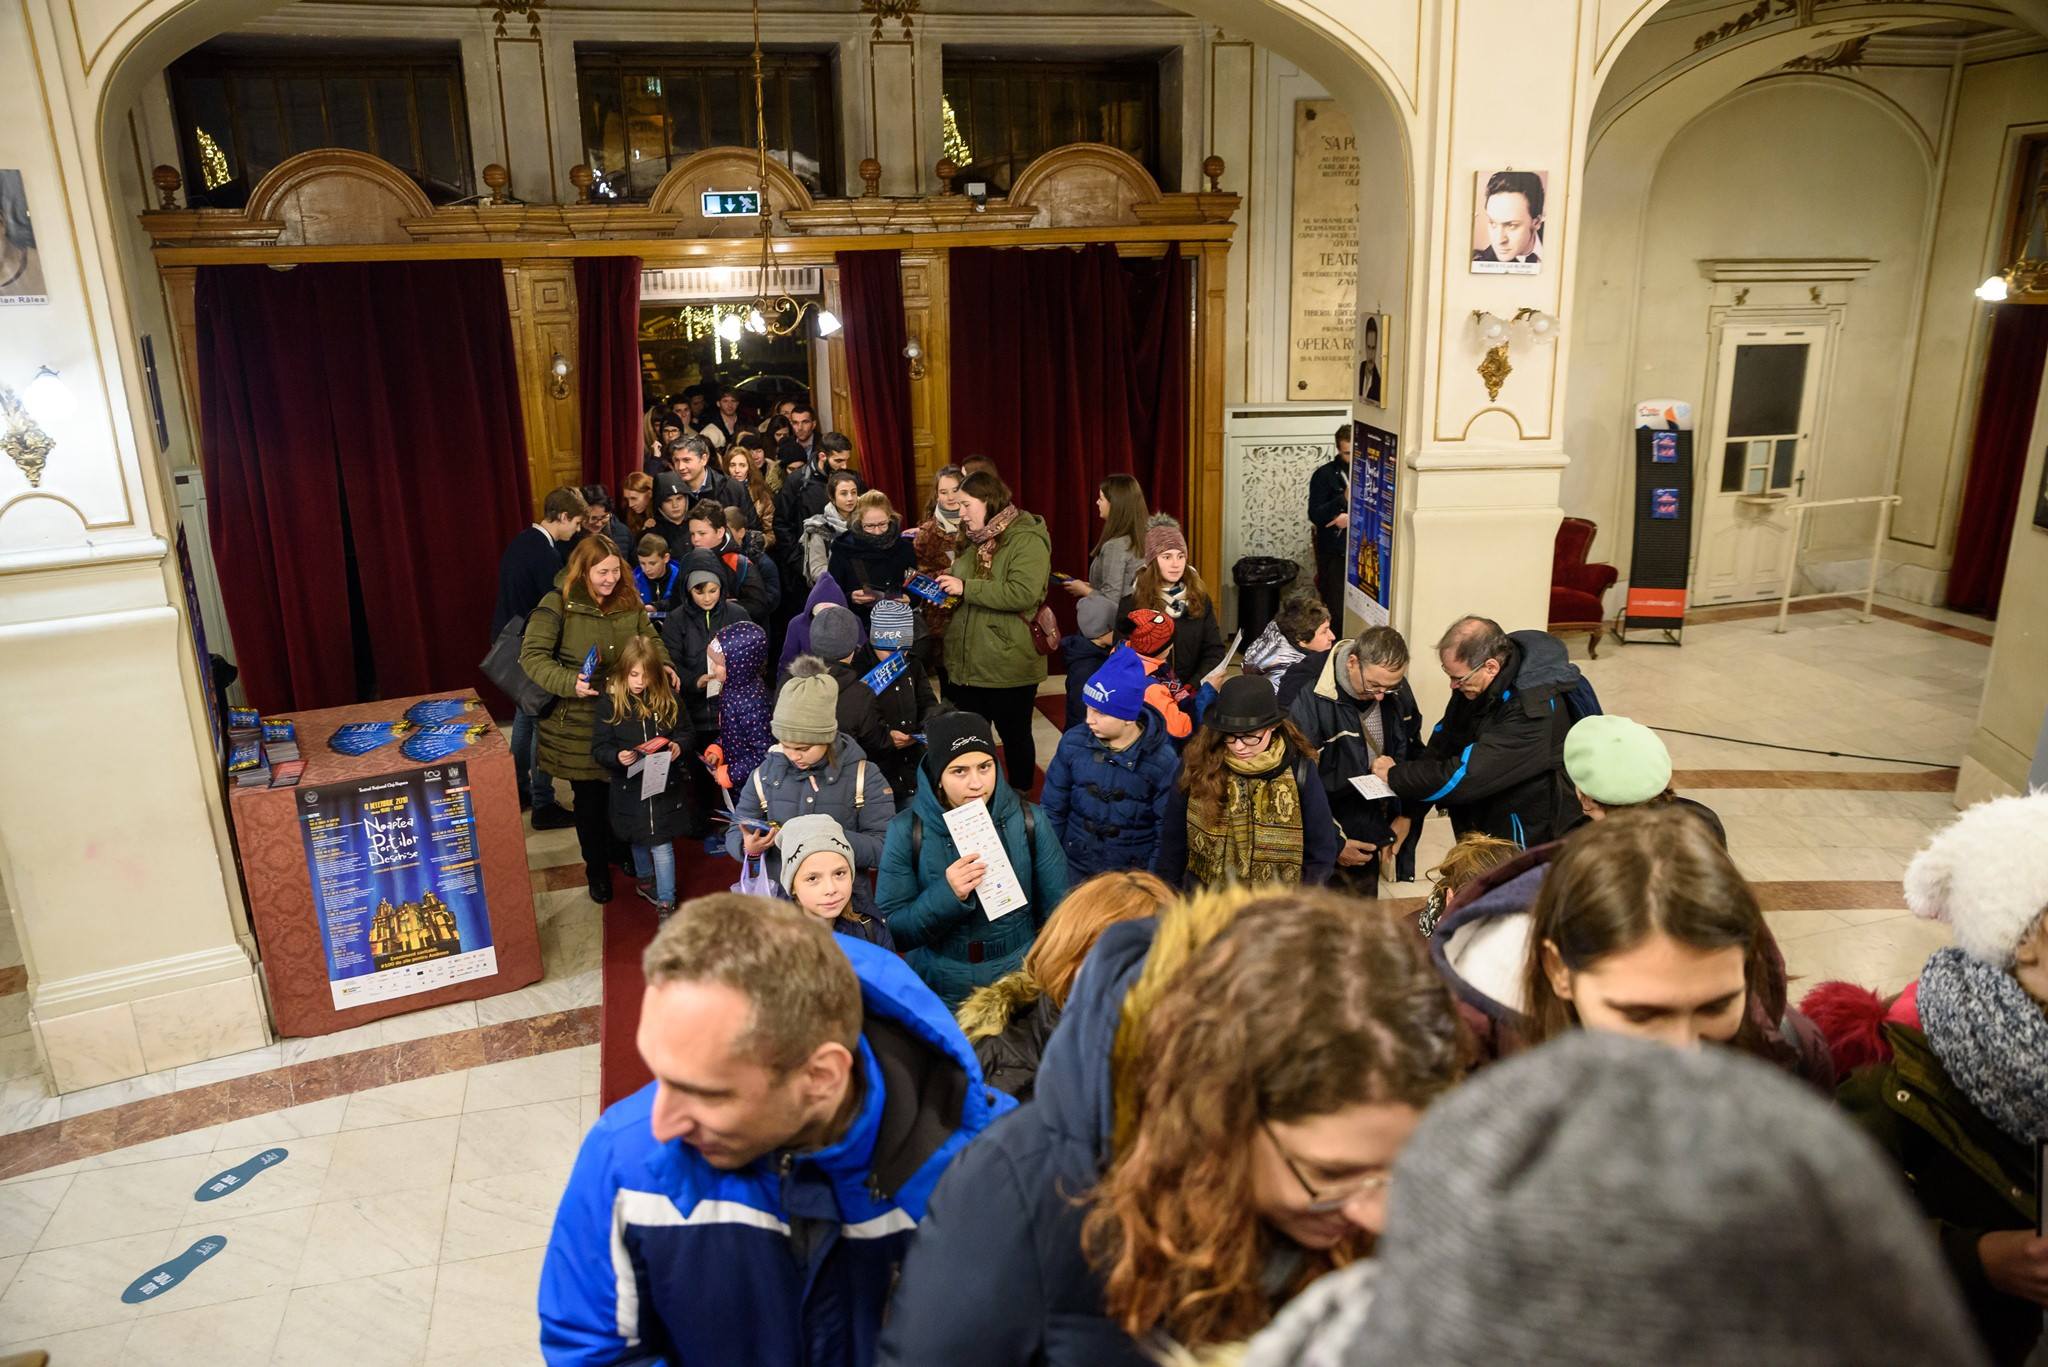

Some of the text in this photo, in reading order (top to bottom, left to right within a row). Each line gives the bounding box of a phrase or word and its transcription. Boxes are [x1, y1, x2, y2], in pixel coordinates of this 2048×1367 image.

[1296, 337, 1340, 351] OPERA
[874, 631, 901, 640] SUPER
[363, 816, 414, 838] Noaptea
[368, 851, 419, 866] Deschise
